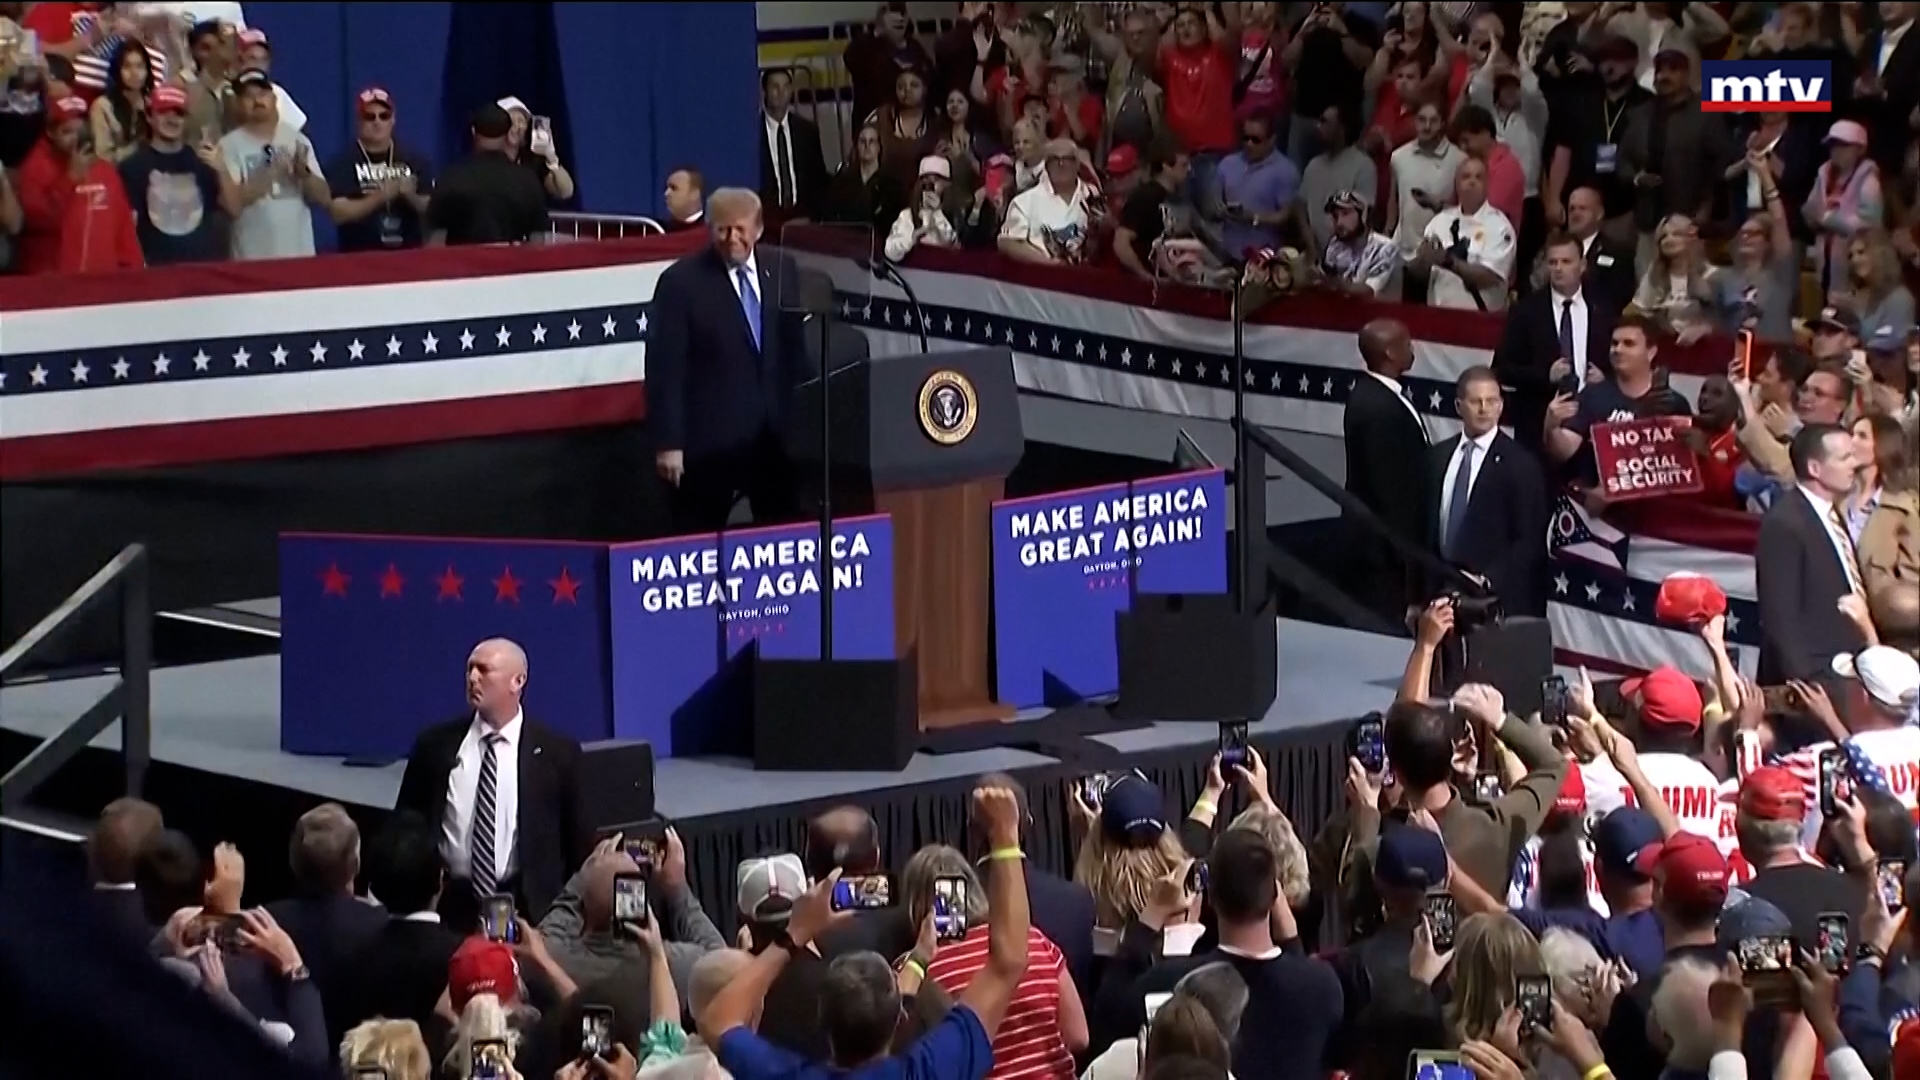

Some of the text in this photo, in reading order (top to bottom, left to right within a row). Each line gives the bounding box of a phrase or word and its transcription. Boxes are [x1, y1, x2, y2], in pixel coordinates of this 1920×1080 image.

[1611, 427, 1675, 447] NO TAX
[1616, 454, 1681, 475] SOCIAL
[1607, 468, 1693, 493] SECURITY
[1011, 486, 1208, 538] MAKE AMERICA
[1020, 516, 1202, 567] GREAT AGAIN!
[631, 549, 719, 583] MAKE
[1121, 556, 1142, 569] OO
[642, 564, 863, 612] GREAT AGAN!
[764, 604, 790, 616] OHIO
[1618, 785, 1718, 819] TUMP
